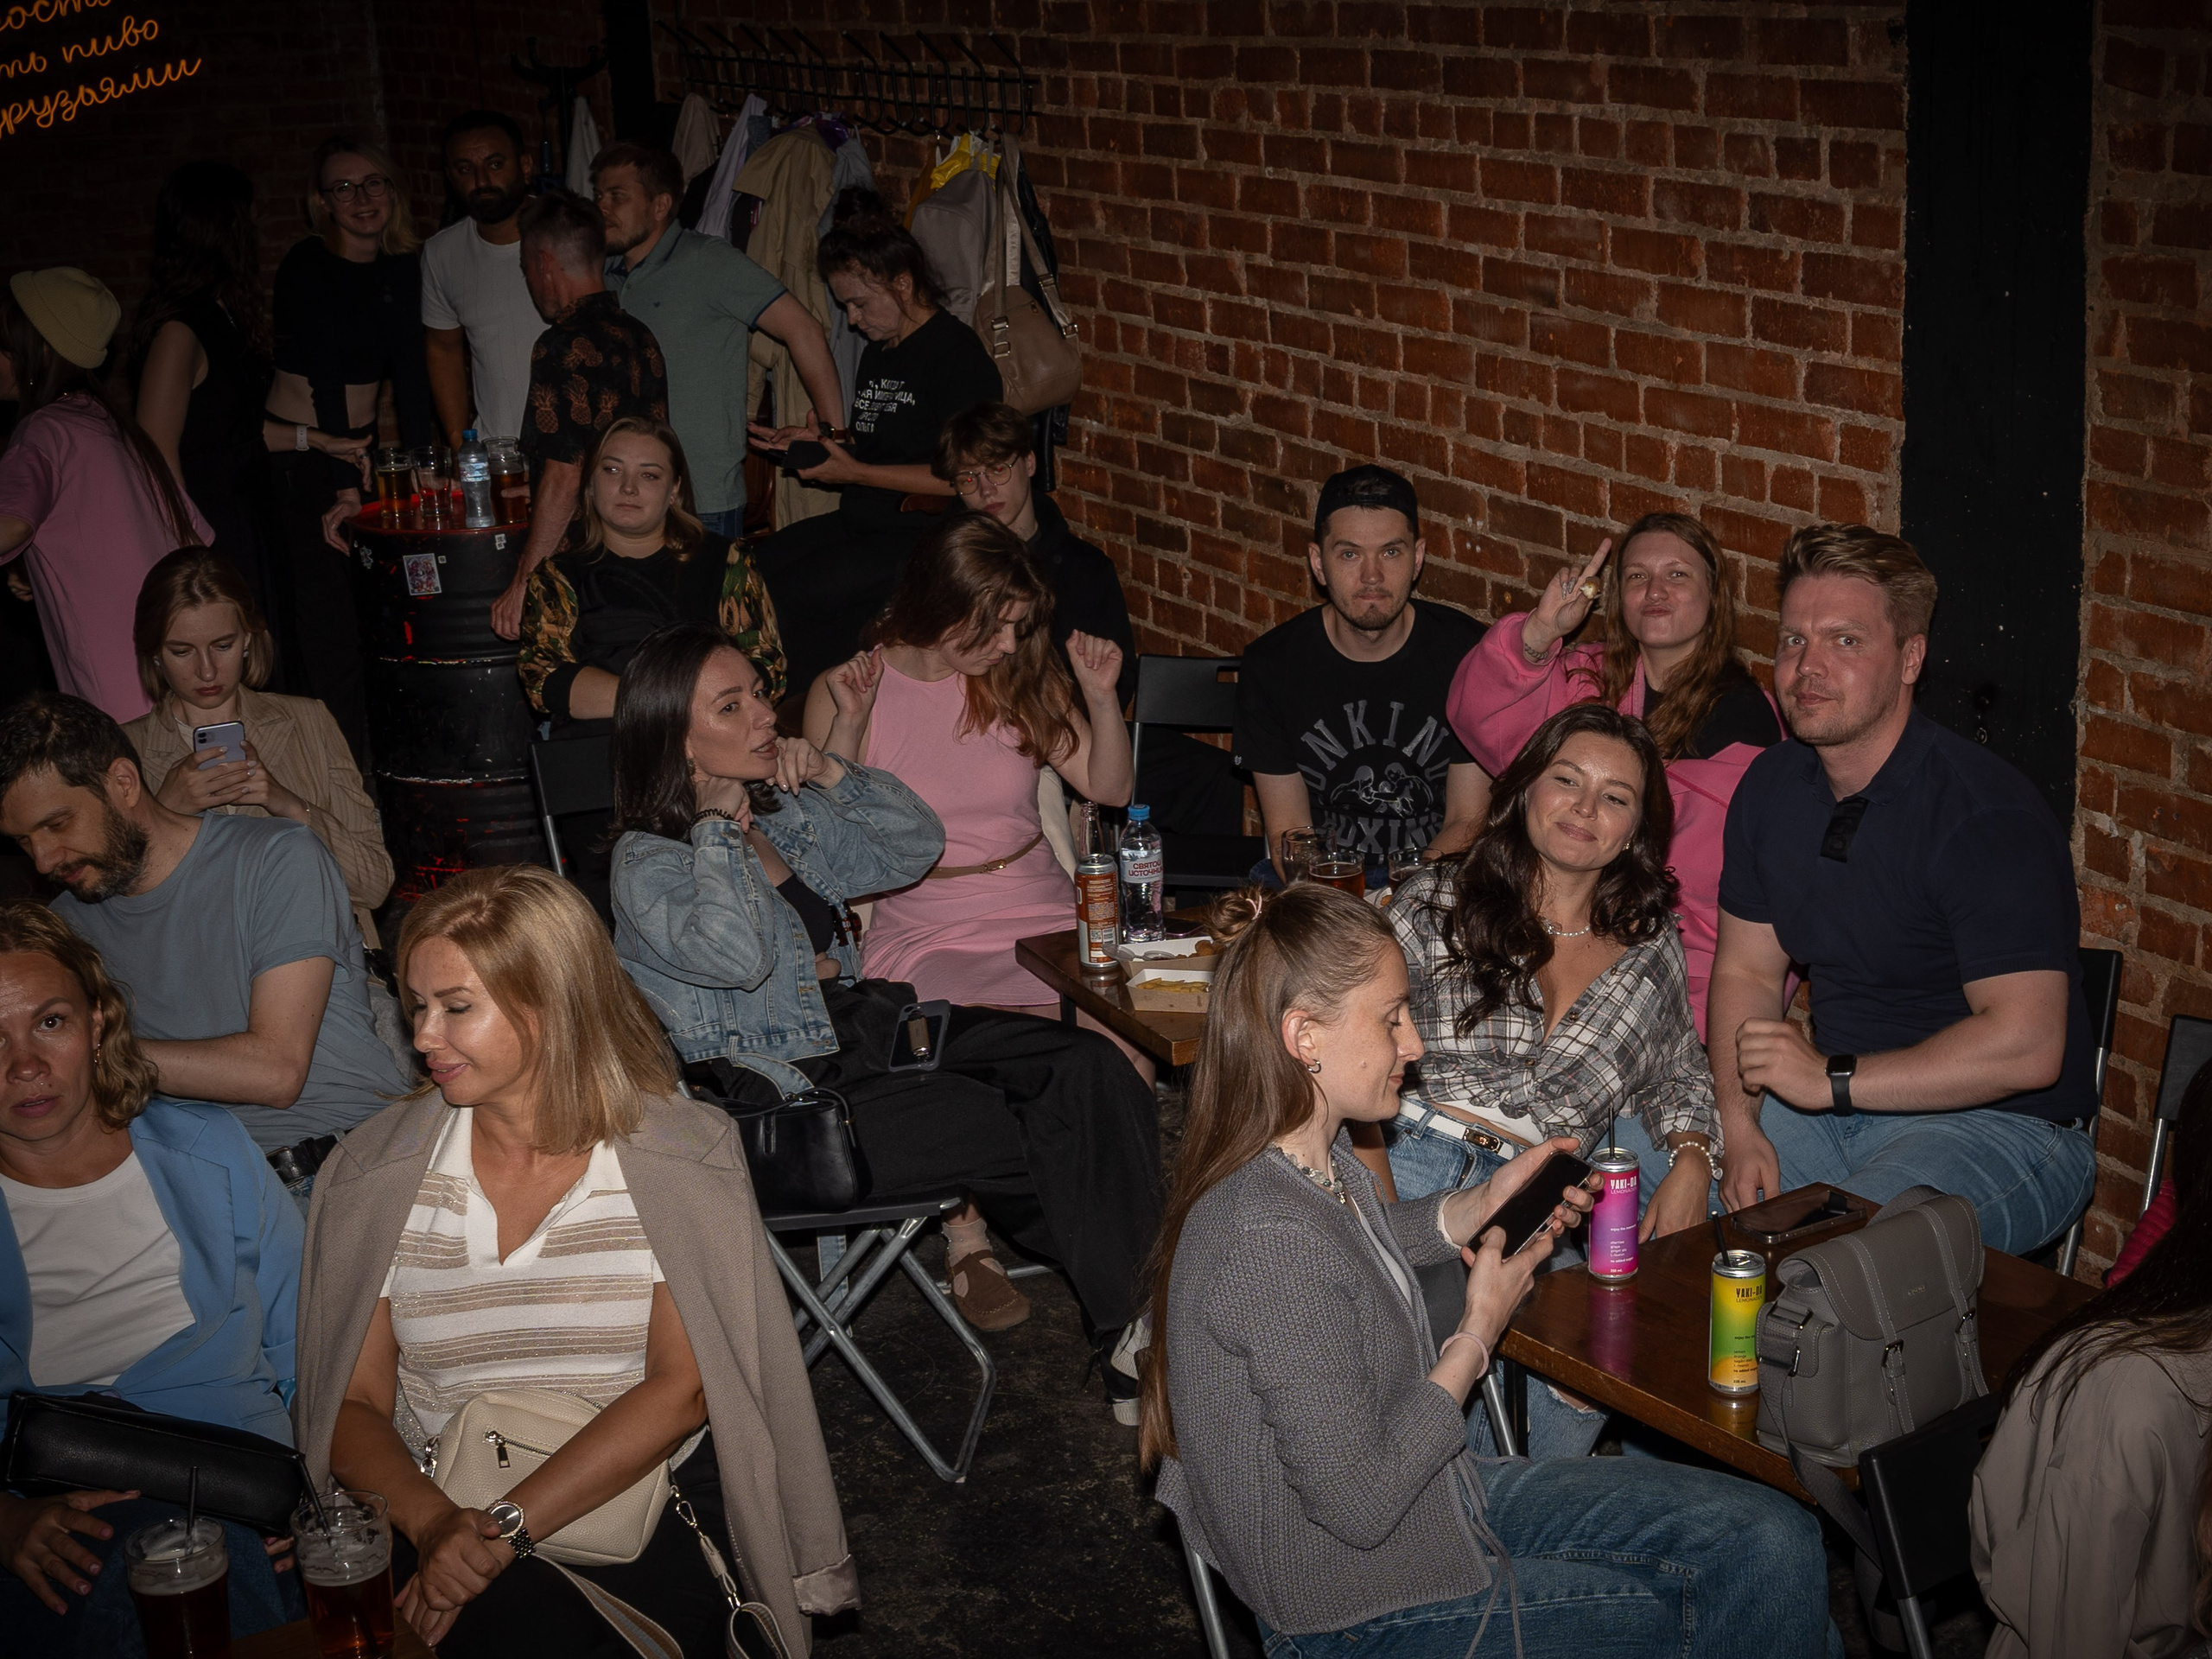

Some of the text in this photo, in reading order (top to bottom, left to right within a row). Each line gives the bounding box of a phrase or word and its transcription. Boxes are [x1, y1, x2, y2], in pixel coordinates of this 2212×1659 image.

[61, 15, 160, 64] пиво
[0, 58, 203, 138] рузьями
[1133, 858, 1162, 869] СВЯТОЙ
